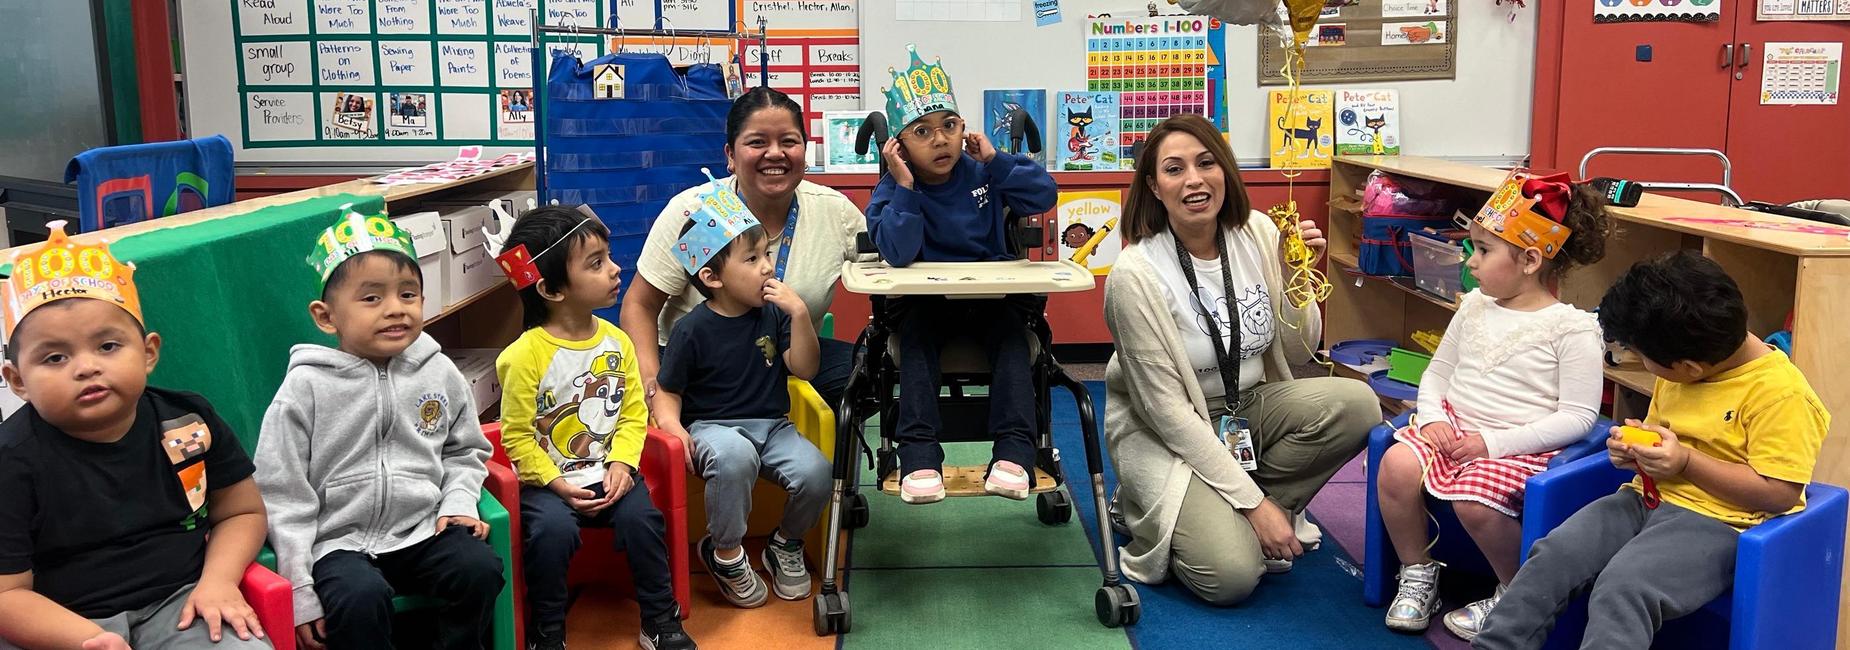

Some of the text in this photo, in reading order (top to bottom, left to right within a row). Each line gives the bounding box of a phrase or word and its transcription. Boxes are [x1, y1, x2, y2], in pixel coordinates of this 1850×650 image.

[347, 4, 364, 15] Too
[463, 5, 480, 15] Too
[1801, 0, 1832, 12] MATTERS
[263, 12, 293, 25] Aloud
[379, 17, 414, 30] Nothing
[498, 14, 527, 27] Weave
[1092, 20, 1158, 35] Numbers
[1164, 20, 1203, 33] 1-100
[248, 44, 283, 60] small
[319, 43, 362, 54] Patterns
[382, 44, 414, 60] Sewing
[442, 45, 475, 60] Mixing
[495, 44, 502, 54] A
[338, 57, 351, 66] on
[510, 56, 520, 66] of
[751, 49, 783, 63] Saff
[818, 49, 854, 63] Breaks
[262, 62, 295, 81] group
[390, 60, 415, 75] Paper
[321, 69, 361, 81] Clothing
[502, 69, 532, 80] Poems
[895, 67, 949, 102] 100
[253, 94, 286, 109] Service
[1065, 93, 1087, 104] Pete
[1095, 94, 1113, 104] Cat
[1276, 92, 1299, 104] Pee
[1308, 93, 1328, 104] Cat
[1343, 91, 1365, 102] Pete
[1373, 92, 1392, 102] Cat
[264, 110, 304, 126] Providers
[338, 114, 363, 130] Betsy
[401, 115, 415, 125] Ma
[508, 111, 527, 122] Ally
[1068, 202, 1112, 217] yellow
[15, 247, 113, 290] 100
[42, 287, 88, 301] Hector
